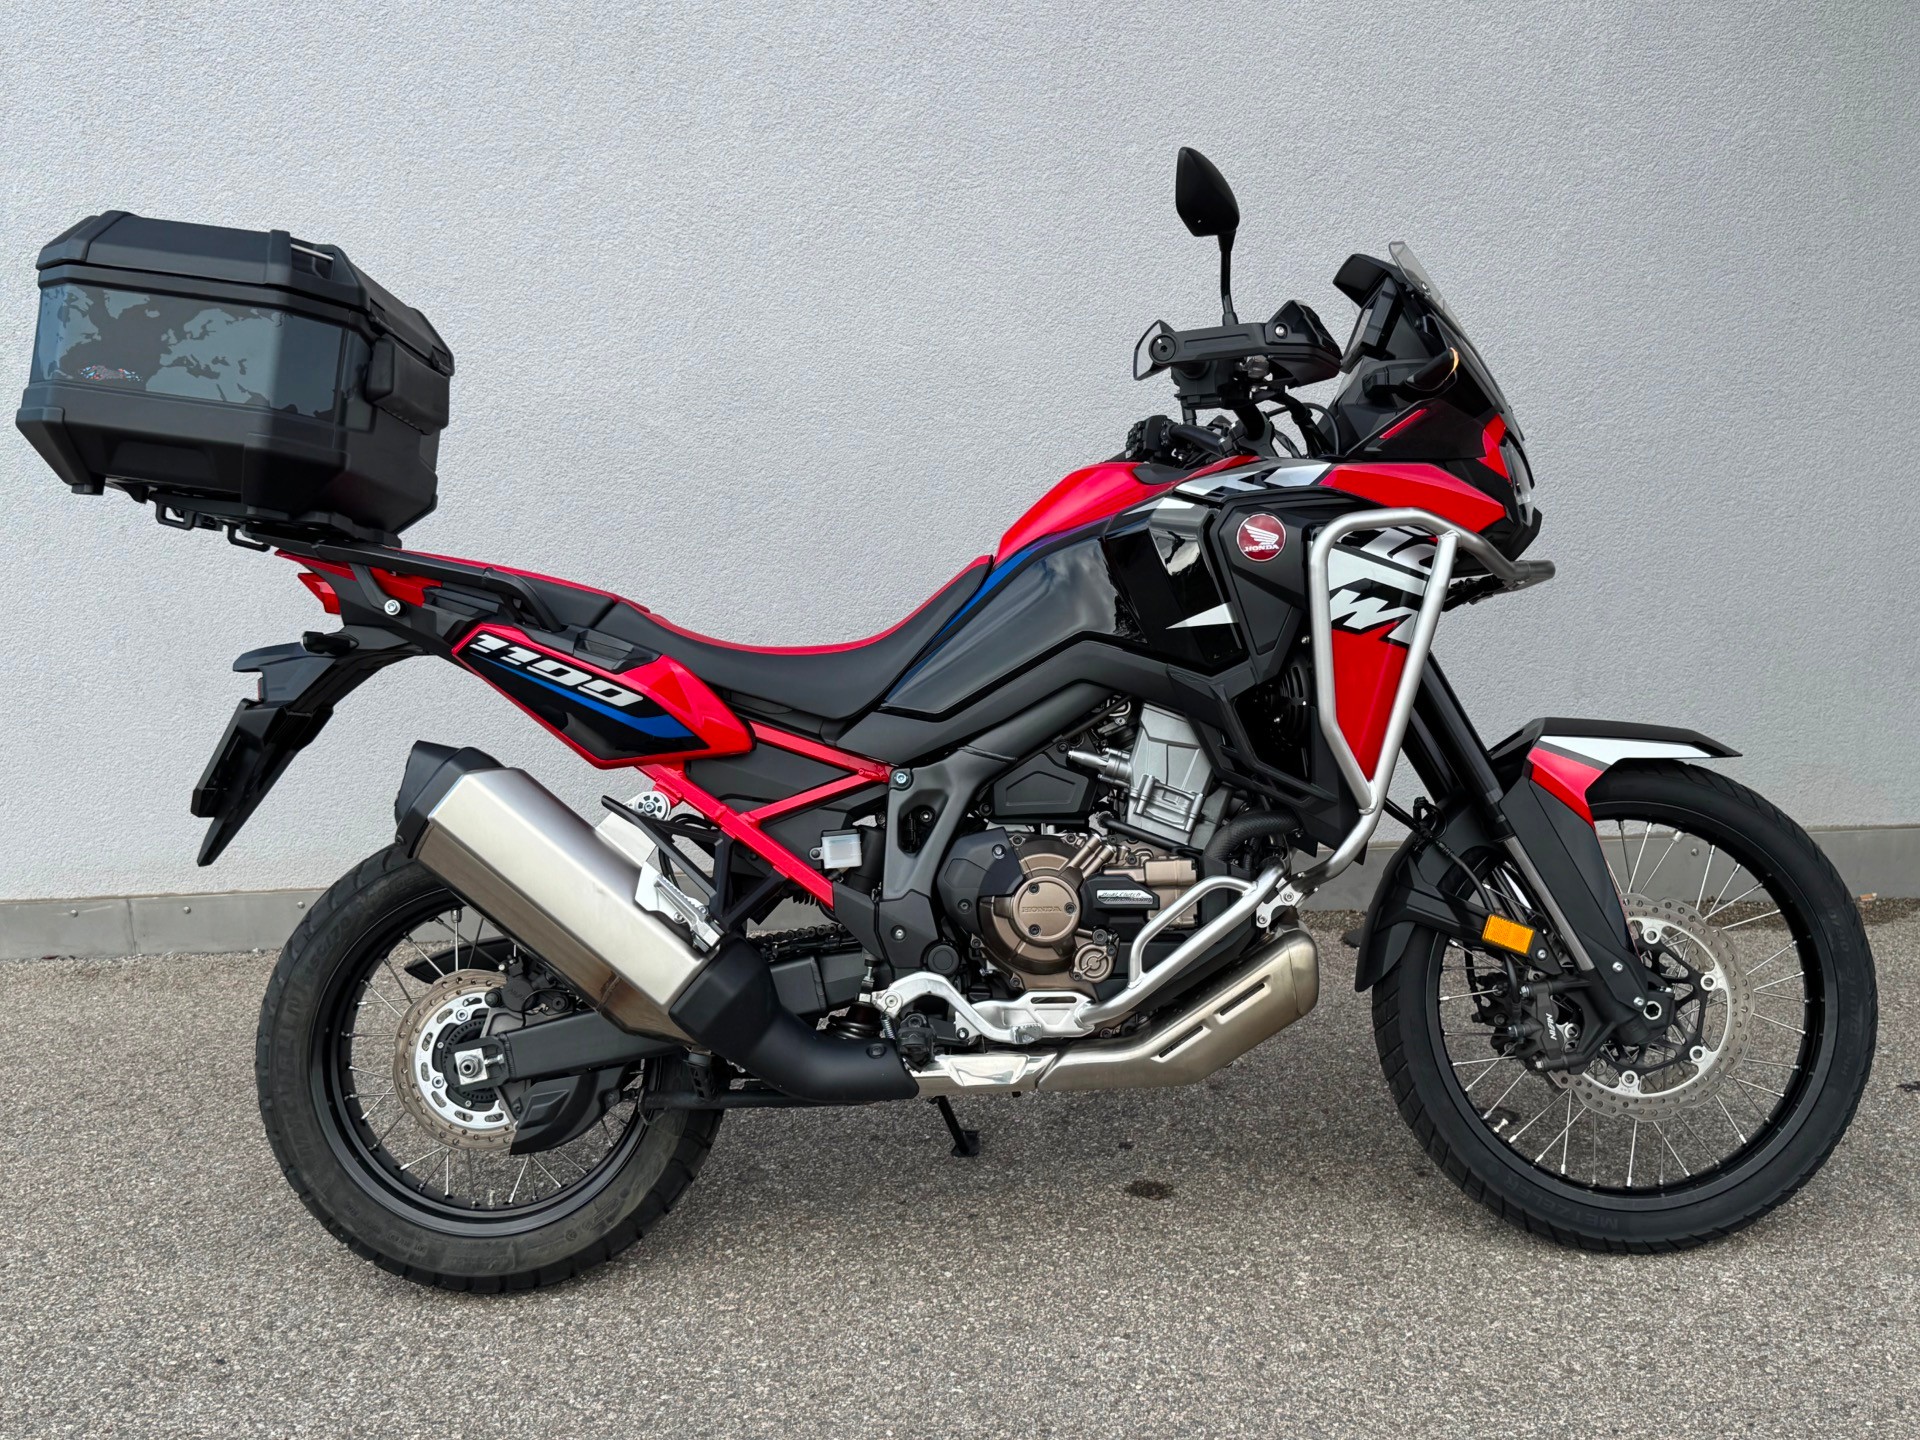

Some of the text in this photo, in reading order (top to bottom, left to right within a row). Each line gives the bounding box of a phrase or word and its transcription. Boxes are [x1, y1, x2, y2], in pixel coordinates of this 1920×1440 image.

[1244, 543, 1280, 552] HONDA
[469, 633, 644, 707] 1100
[1021, 905, 1062, 913] HONDA
[1503, 1170, 1619, 1231] METZELER
